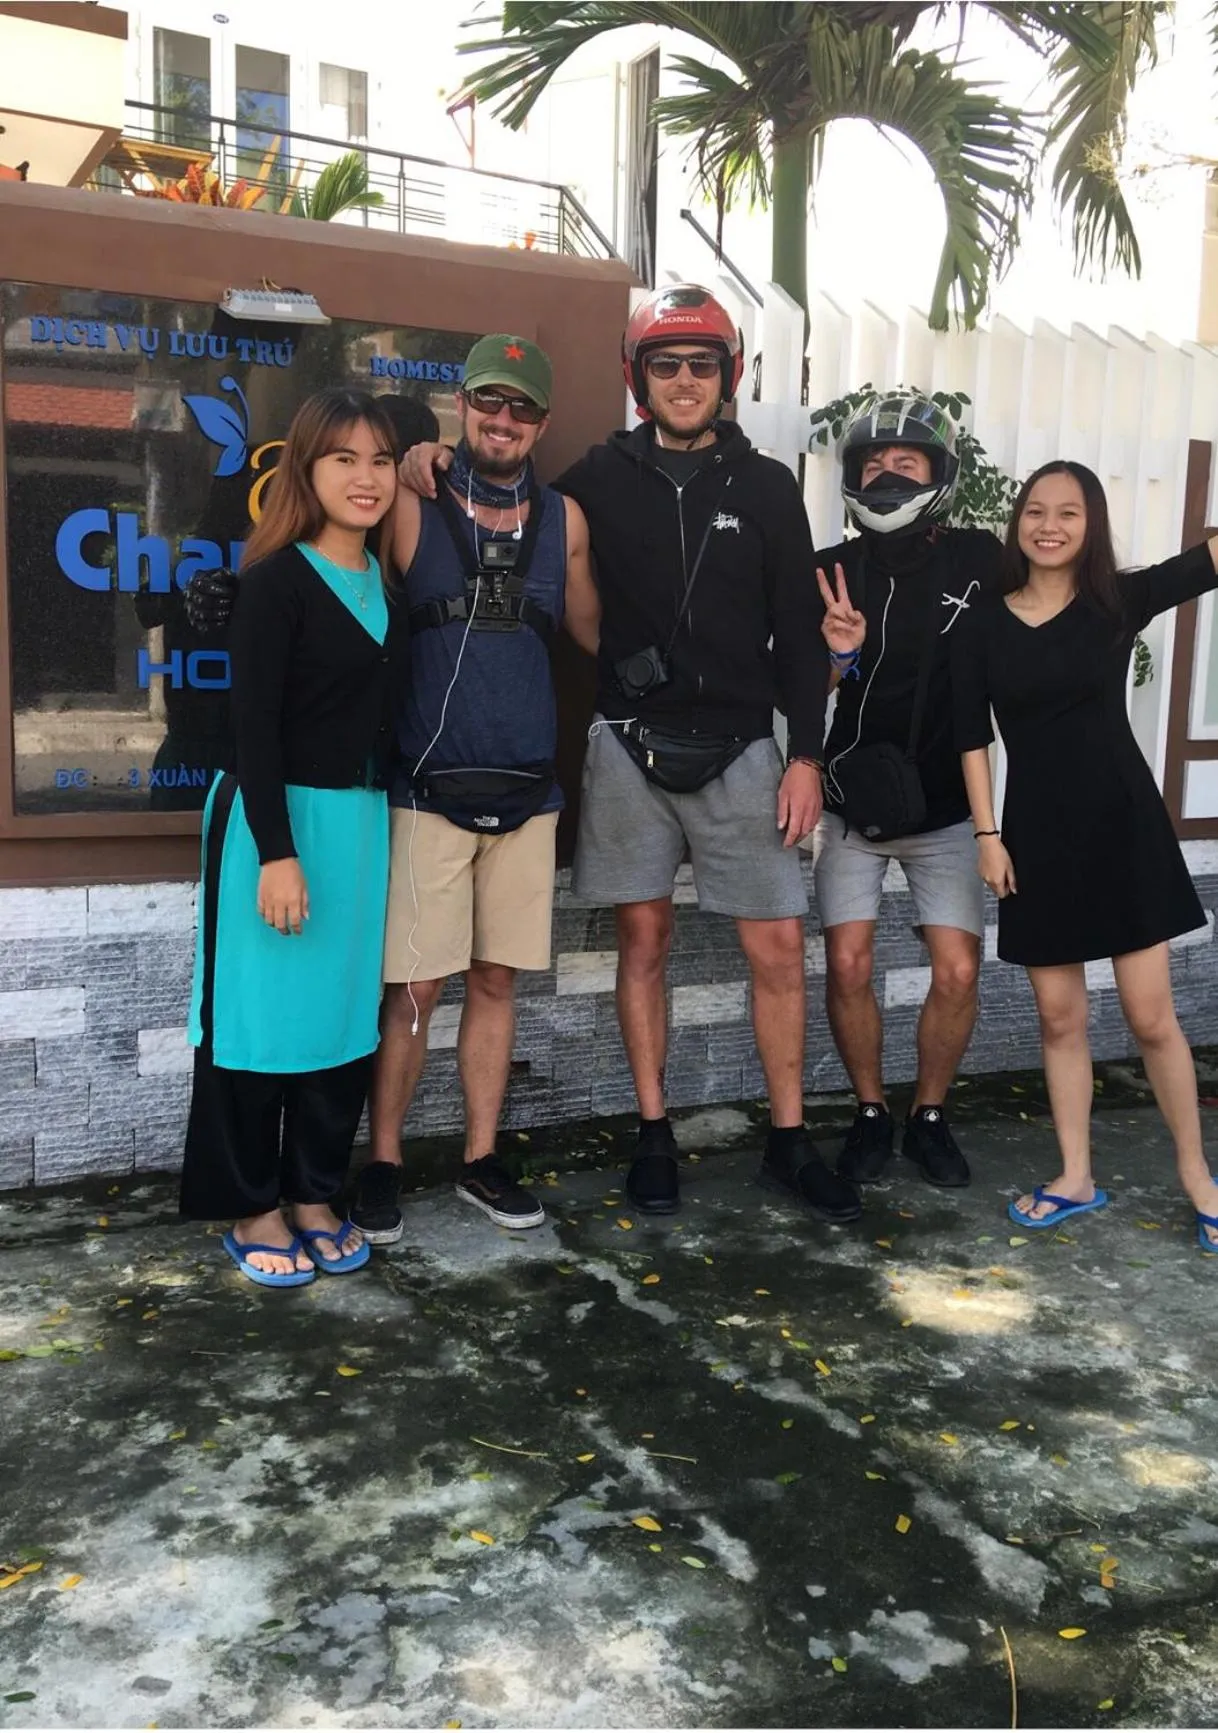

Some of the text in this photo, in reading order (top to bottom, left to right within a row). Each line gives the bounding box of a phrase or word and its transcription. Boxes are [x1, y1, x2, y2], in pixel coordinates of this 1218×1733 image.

[659, 315, 703, 325] HONDA
[31, 316, 107, 354] DỊCH
[114, 323, 160, 360] VỤ
[235, 336, 294, 368] TRÚ
